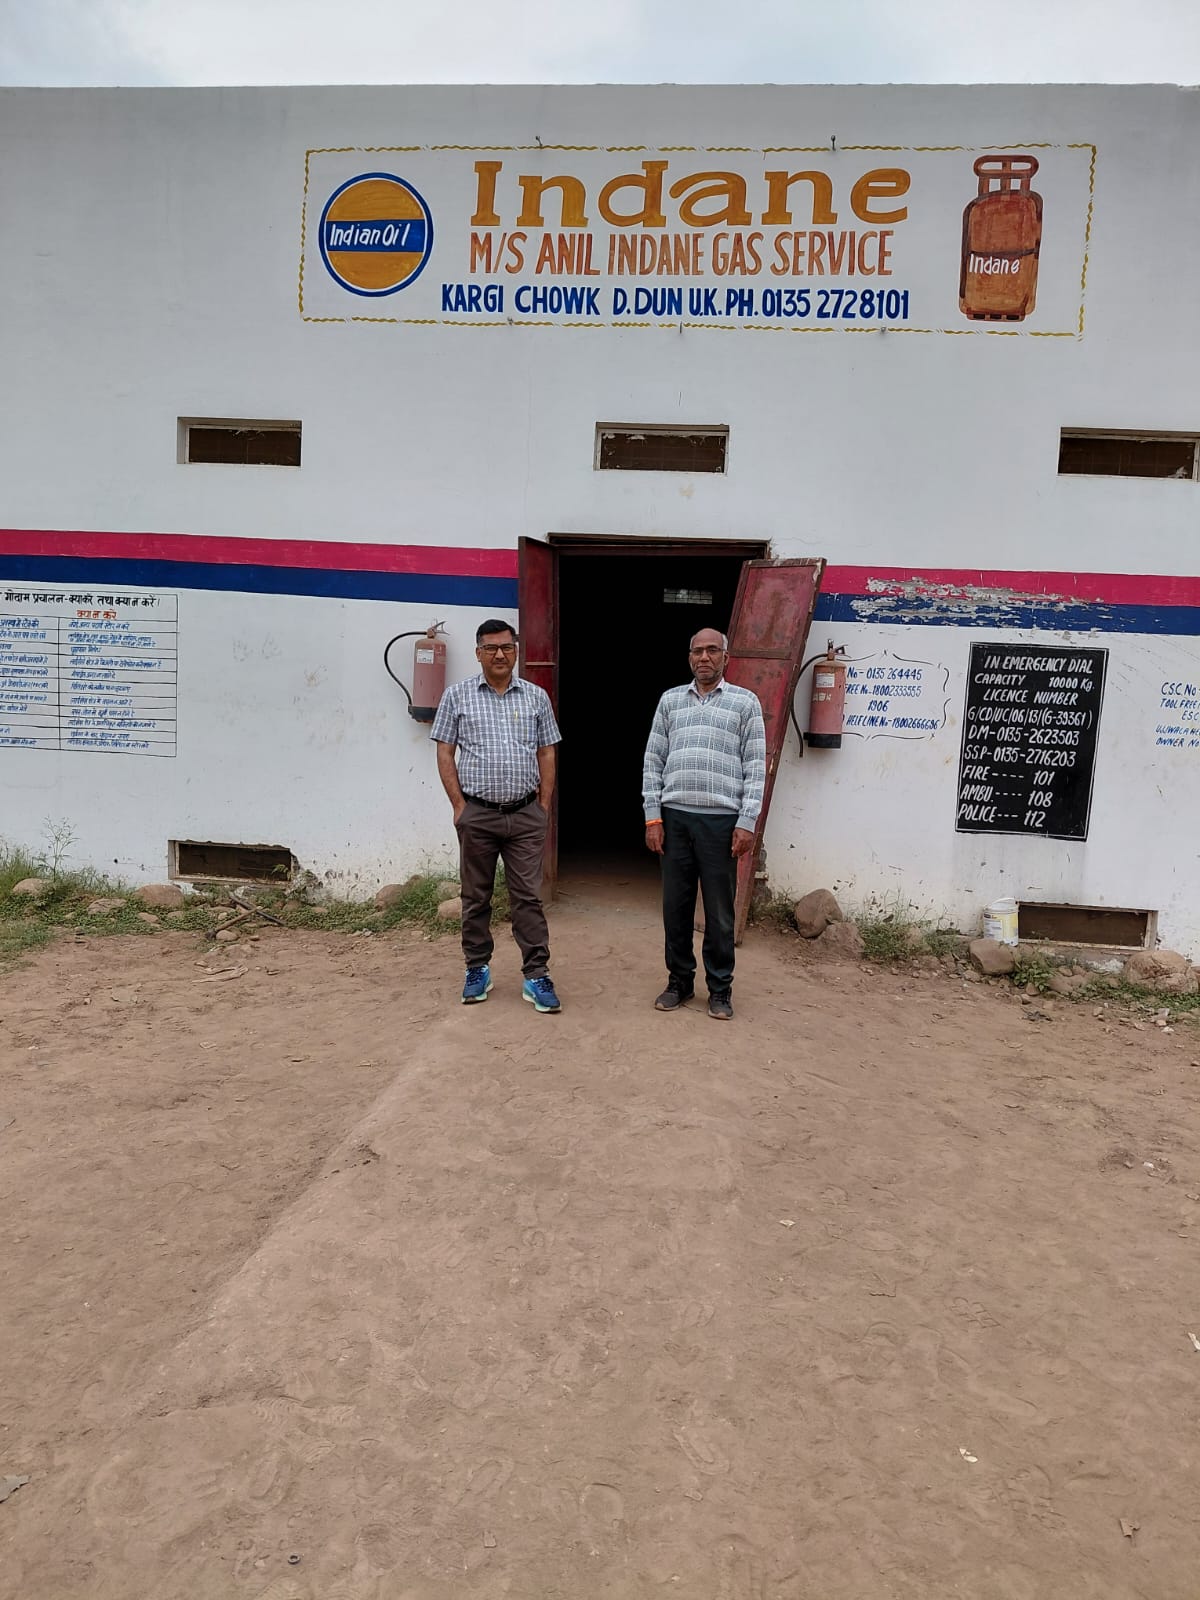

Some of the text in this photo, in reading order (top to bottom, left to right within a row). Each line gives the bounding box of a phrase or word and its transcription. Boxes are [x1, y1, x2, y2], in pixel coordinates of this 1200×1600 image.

[470, 160, 911, 228] Indane
[469, 230, 894, 276] M/S ANIL INDANE GAS SERVICE
[968, 253, 1021, 275] Indane
[441, 283, 504, 313] KARGI
[514, 284, 600, 315] CHOWK
[612, 287, 682, 316] D.DUN
[816, 289, 910, 320] 2728101
[983, 655, 1094, 674] IN EMERGENCY DIAL
[974, 673, 1026, 686] CAPACITY
[1048, 676, 1079, 690] 10000
[868, 700, 890, 712] 1906
[983, 688, 1079, 706] LICENCE NUMBER
[1033, 769, 1056, 786] 101
[1027, 790, 1054, 808] 108
[1023, 809, 1046, 828] 112
